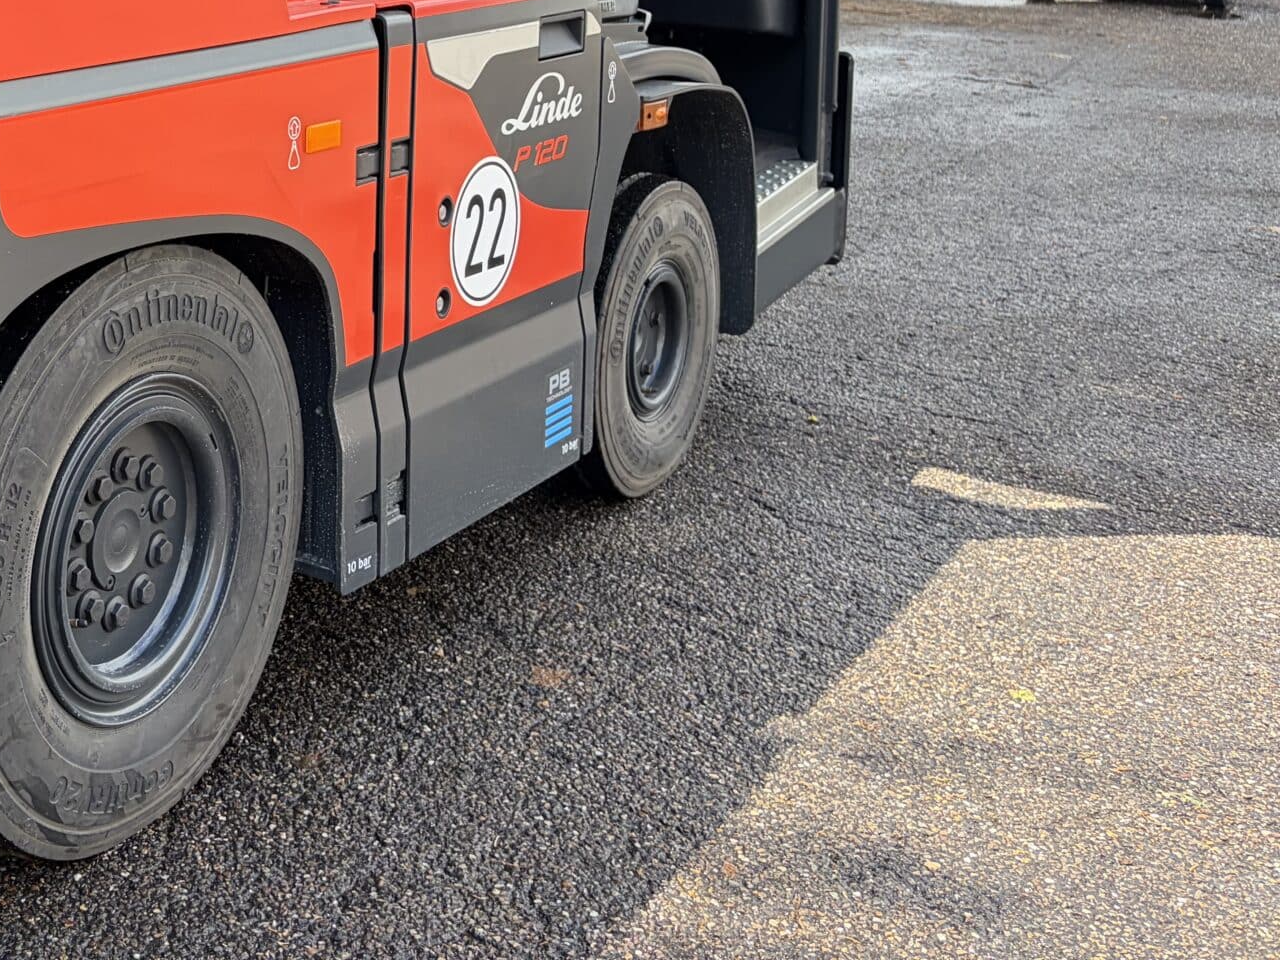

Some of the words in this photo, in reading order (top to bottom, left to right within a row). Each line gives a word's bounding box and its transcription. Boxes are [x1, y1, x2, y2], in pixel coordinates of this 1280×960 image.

[501, 72, 583, 135] Linde
[513, 144, 531, 173] P
[534, 134, 569, 167] 120
[465, 187, 507, 279] 22
[102, 289, 239, 358] Continental
[549, 368, 570, 395] PB
[5, 482, 23, 512] 12
[347, 560, 357, 575] 10
[358, 555, 372, 570] bar
